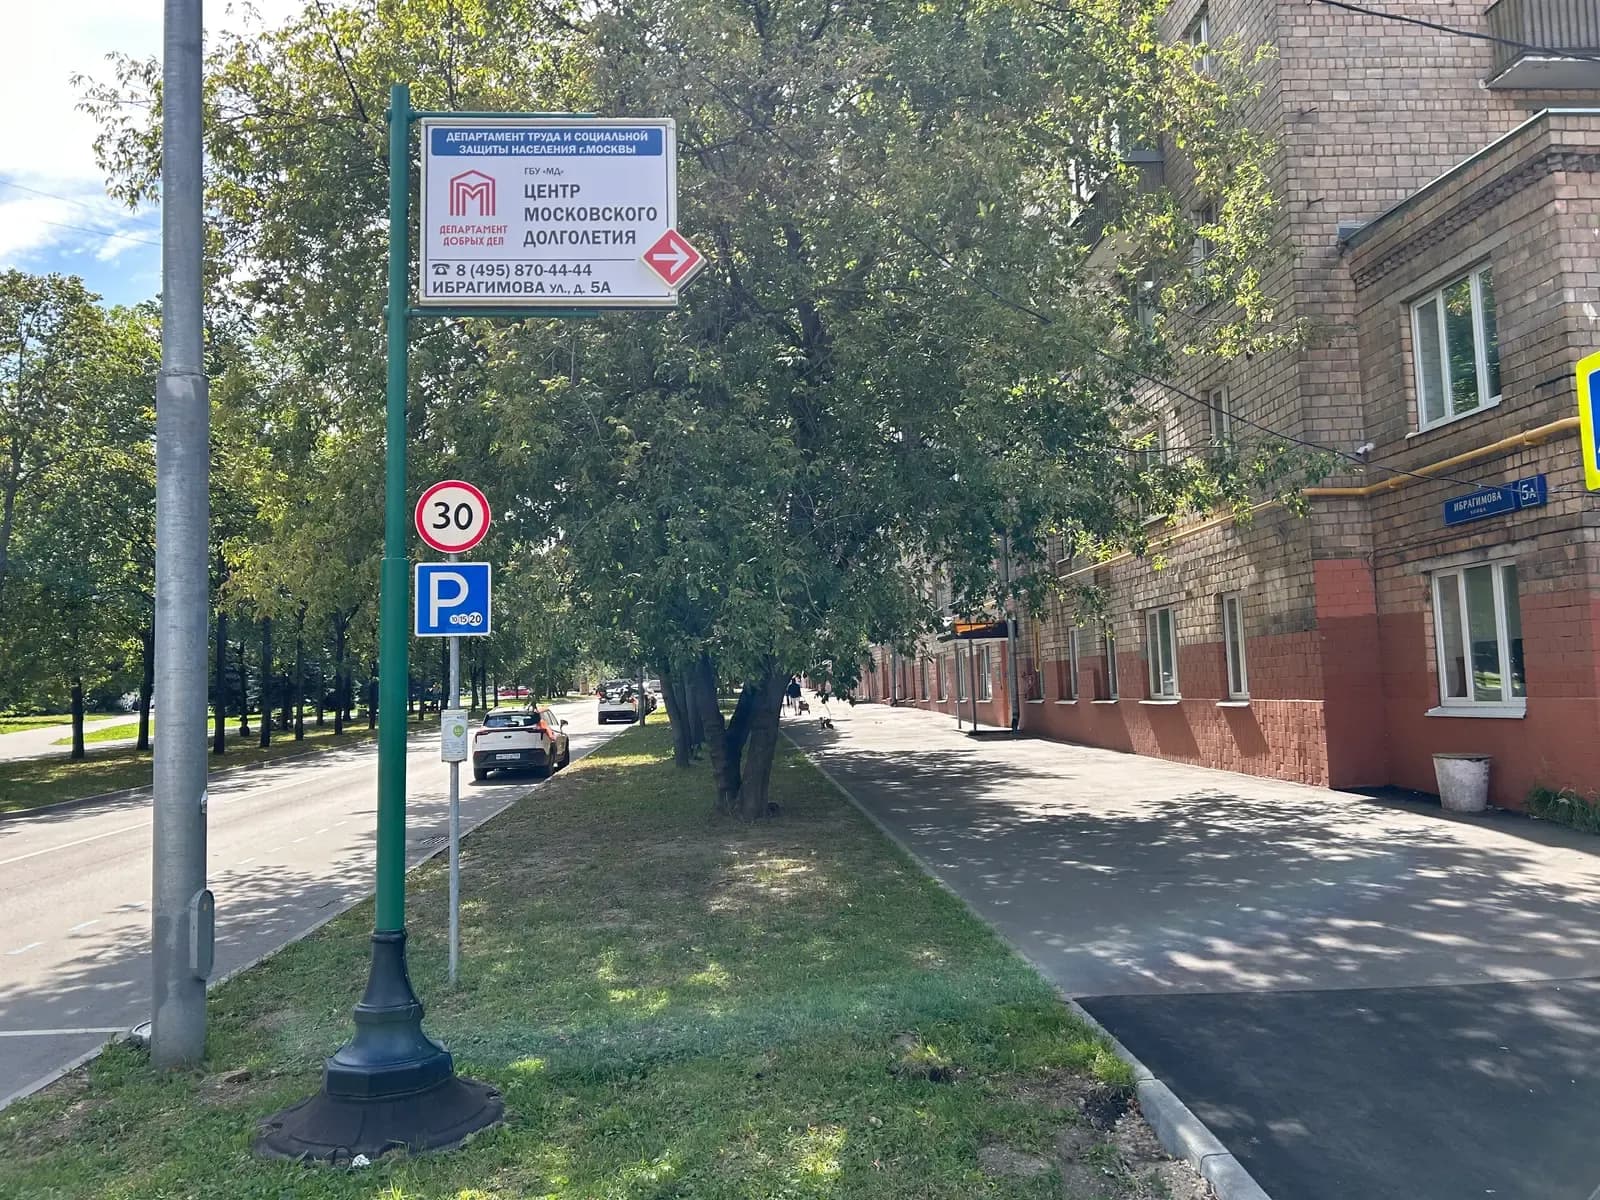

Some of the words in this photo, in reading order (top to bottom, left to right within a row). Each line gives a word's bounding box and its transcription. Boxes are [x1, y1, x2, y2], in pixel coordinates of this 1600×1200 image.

[446, 132, 525, 143] ДЕПАРТАМЕНТ
[528, 132, 561, 142] ТРУДА
[563, 132, 572, 142] И
[574, 131, 649, 142] СОЦИАЛЬНОЙ
[459, 145, 509, 155] ЗАЩИТЫ
[511, 145, 577, 155] НАСЕЛЕНИЯ
[524, 167, 541, 176] ГБУ
[524, 183, 581, 201] ЦЕНТР
[524, 206, 658, 222] МОСКОВСКОГО
[439, 224, 508, 236] ДЕПАРТАМЕНТ
[443, 236, 485, 247] ДОБРЫХ
[486, 236, 504, 247] ДЕЛ
[523, 229, 636, 248] ДОЛГОЛЕТИЯ
[456, 263, 466, 276] 8
[470, 263, 511, 279] (495)
[514, 263, 593, 276] 870-44-44
[432, 281, 545, 293] ИБРАГИМОВА
[590, 281, 611, 293] 5А
[1454, 491, 1502, 512] ИБРАГИМОВА
[432, 501, 473, 531] 30
[430, 572, 469, 627] P
[460, 615, 467, 623] 15
[469, 614, 482, 624] 20
